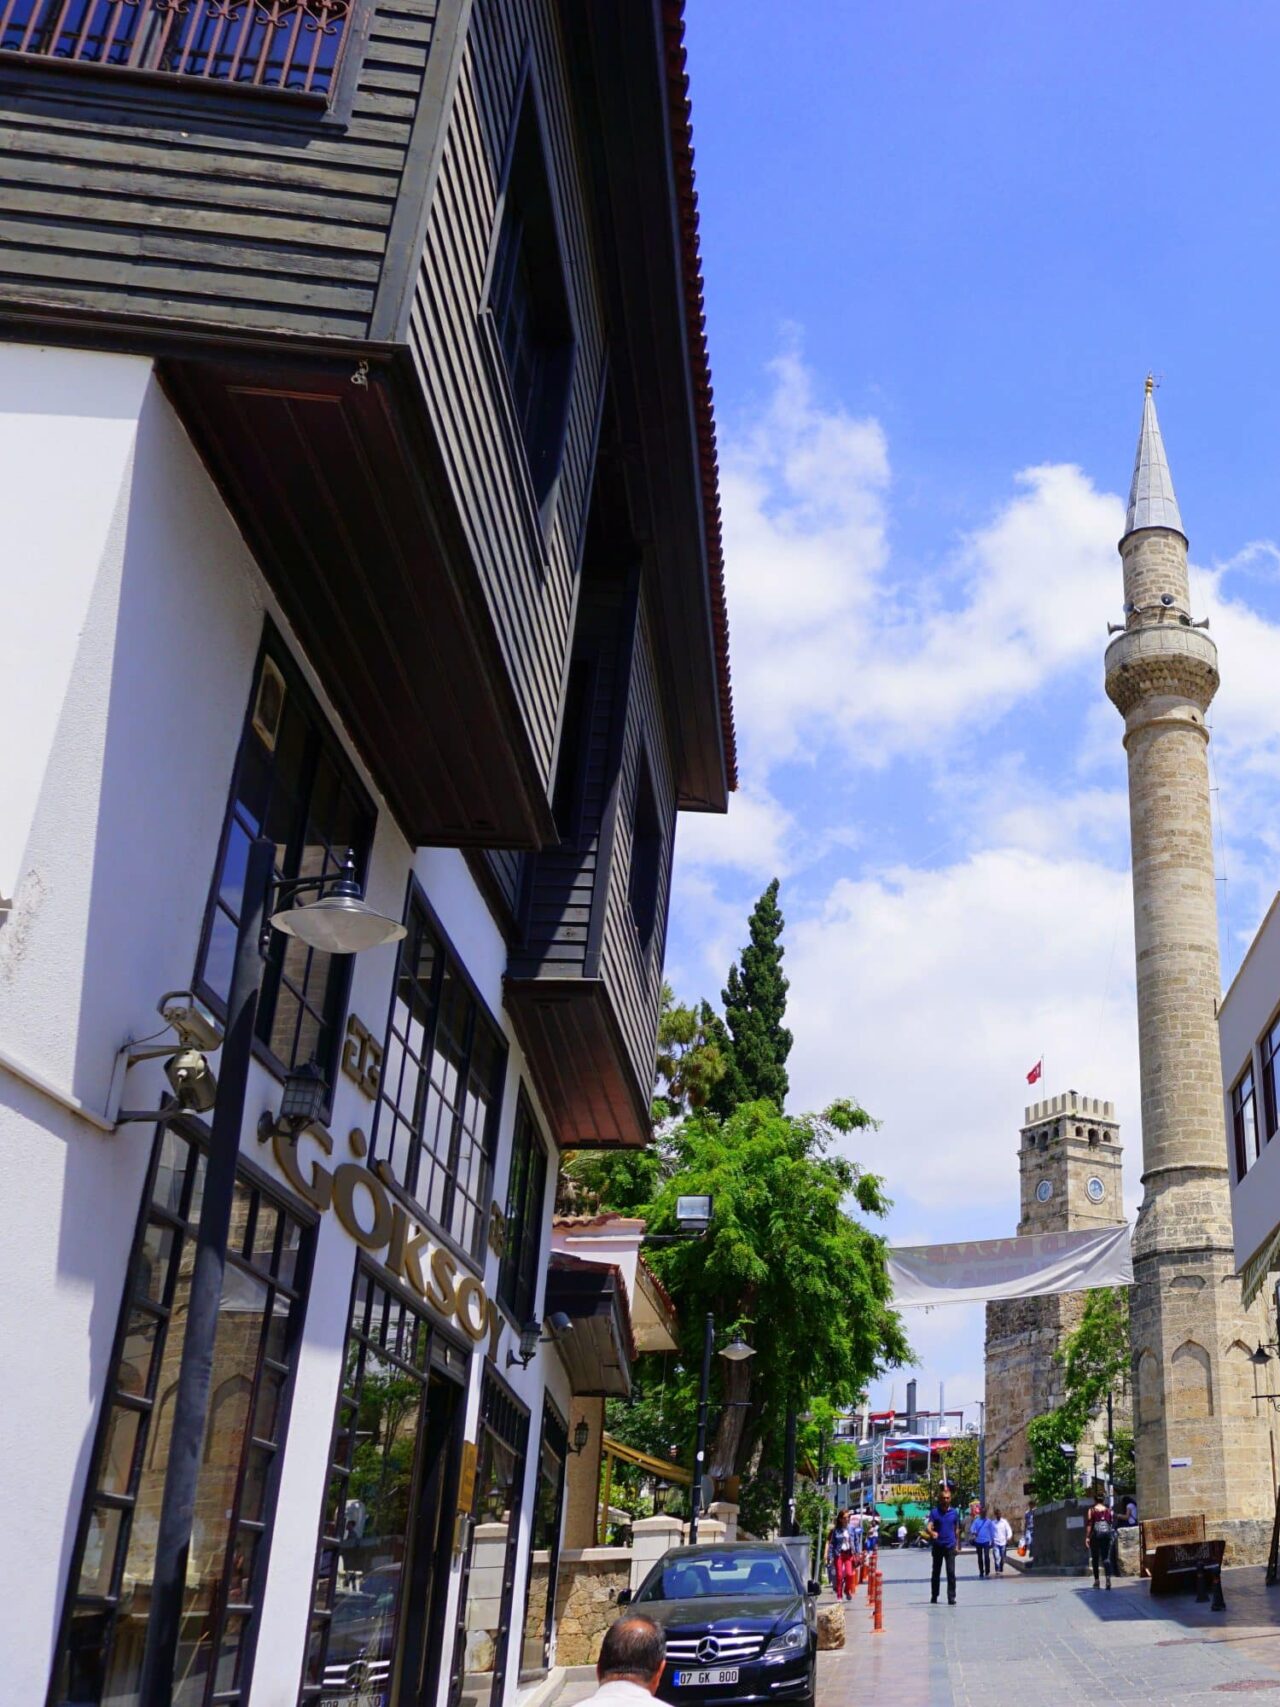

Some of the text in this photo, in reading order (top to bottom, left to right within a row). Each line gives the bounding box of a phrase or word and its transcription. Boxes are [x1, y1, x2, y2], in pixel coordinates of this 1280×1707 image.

[272, 1114, 506, 1363] GÖKSOY
[680, 1670, 737, 1685] 07 GK 800
